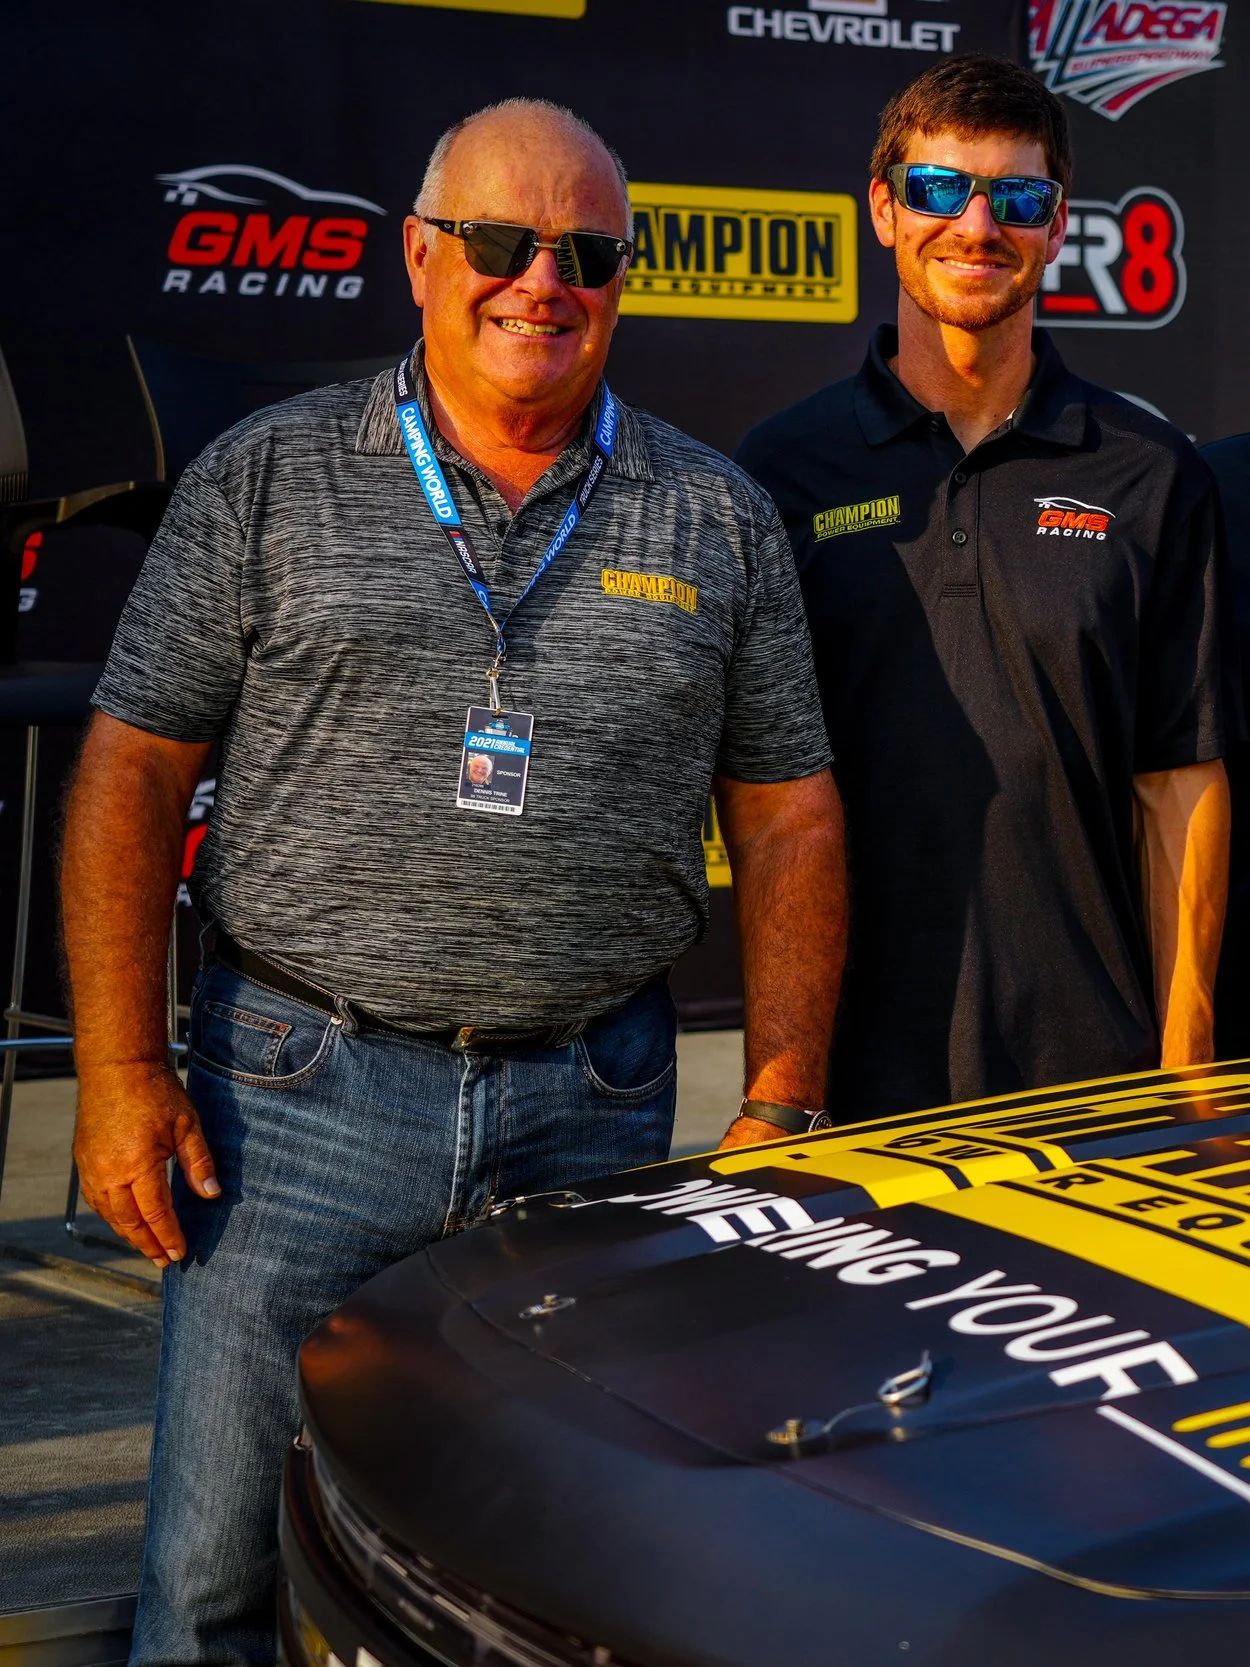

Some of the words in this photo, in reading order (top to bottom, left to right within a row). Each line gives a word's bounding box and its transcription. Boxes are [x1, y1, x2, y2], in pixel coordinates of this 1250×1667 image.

[727, 6, 960, 52] CHEVROLET
[167, 211, 368, 271] GMS
[630, 211, 836, 278] AMPION
[1041, 202, 1176, 315] FR8
[162, 269, 365, 299] RACING
[401, 407, 431, 466] CAMPING
[420, 462, 453, 520] WORLD
[814, 497, 899, 532] CHAMPION
[816, 525, 847, 539] POWER
[846, 516, 898, 532] EQUIPMENT
[1038, 509, 1109, 532] GMS
[545, 513, 576, 562] WORLD
[1036, 526, 1107, 541] RACING
[454, 539, 478, 575] NASCAR
[603, 570, 698, 607] CHAMPION
[469, 736, 494, 749] 2021
